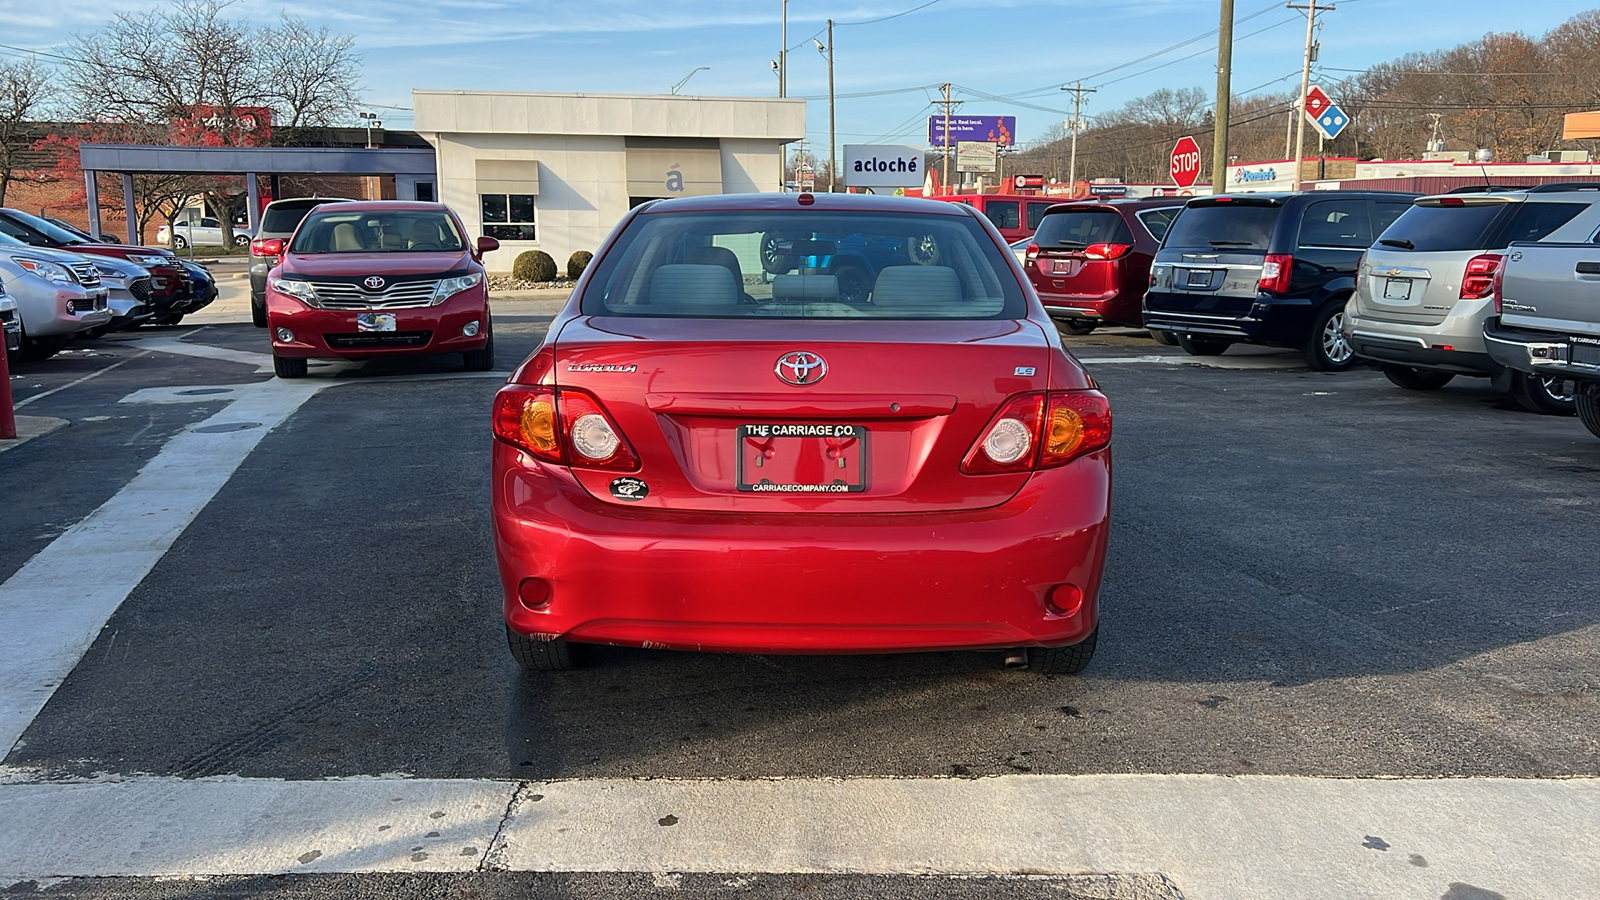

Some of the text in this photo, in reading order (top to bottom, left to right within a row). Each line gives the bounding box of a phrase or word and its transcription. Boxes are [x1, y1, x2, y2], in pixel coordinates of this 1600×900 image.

[854, 156, 918, 173] acloché
[1173, 151, 1199, 174] STOP
[666, 162, 685, 192] á
[1242, 167, 1276, 181] Domino's
[567, 363, 638, 373] COROLLA
[746, 425, 856, 436] THE CARRIAGE CO.
[752, 484, 849, 493] CARRIAGECOMPANY.COM
